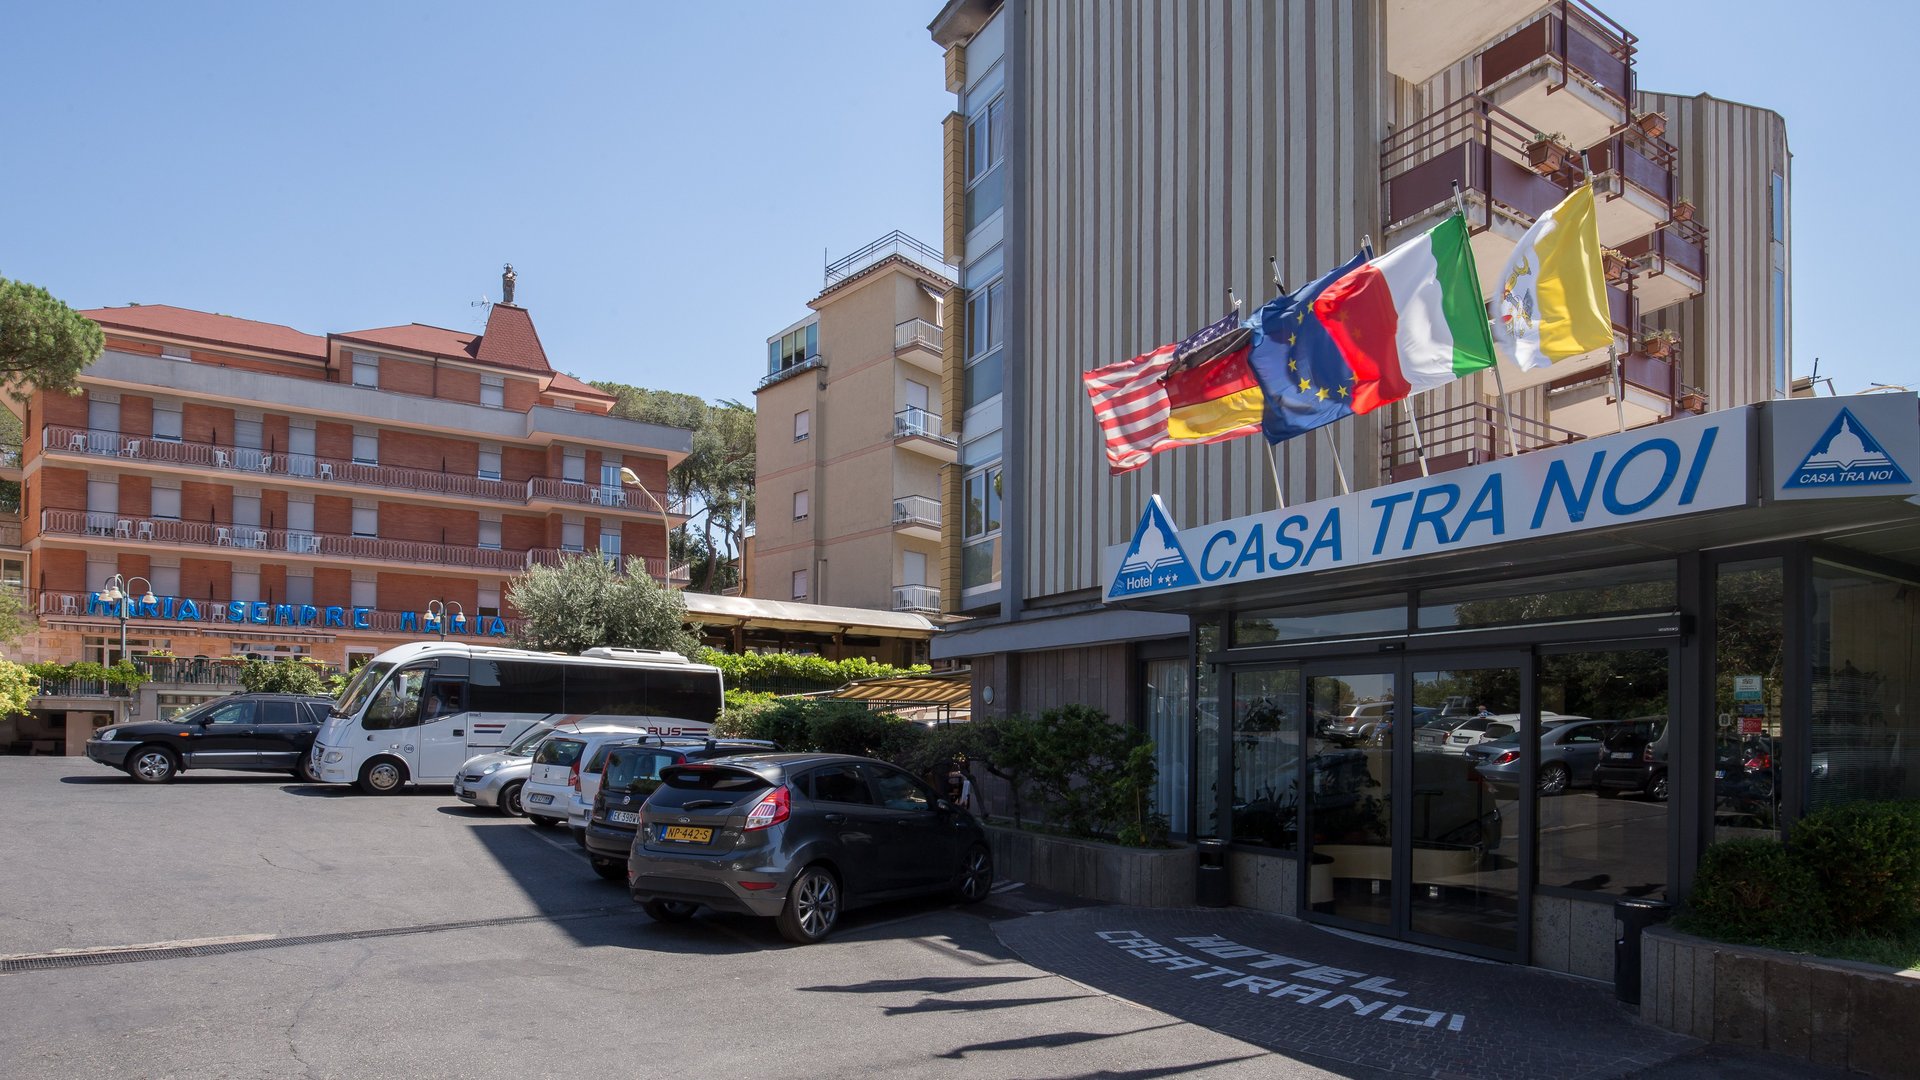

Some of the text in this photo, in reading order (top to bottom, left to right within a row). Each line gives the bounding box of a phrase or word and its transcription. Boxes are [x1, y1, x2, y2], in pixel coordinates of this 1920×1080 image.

[1800, 470, 1893, 484] CASA TRA NOI
[1200, 426, 1719, 582] CASA TRA NOI
[1126, 574, 1153, 590] Hotel
[87, 591, 507, 636] MARIA SEMPRE MARIA
[667, 827, 709, 840] NP-442-S
[1174, 933, 1408, 998] HOTEL
